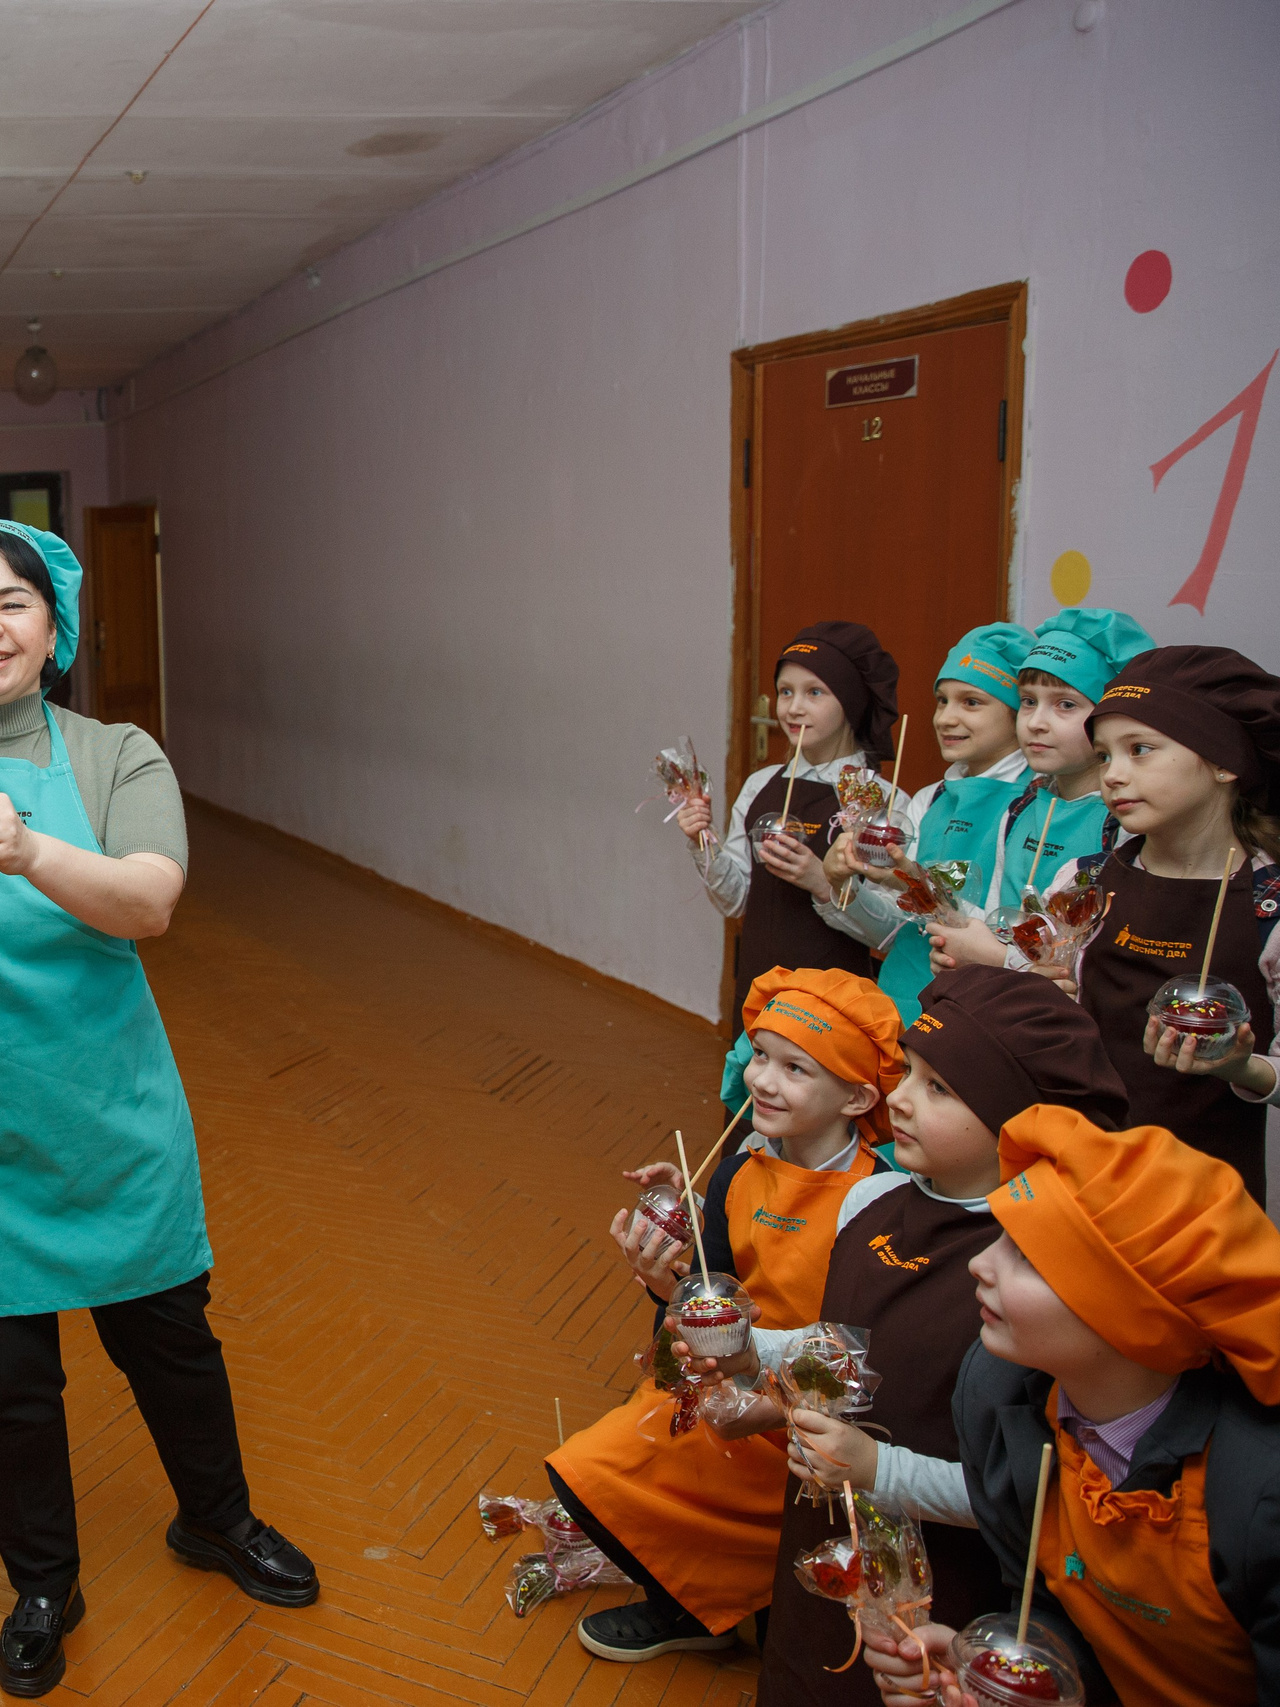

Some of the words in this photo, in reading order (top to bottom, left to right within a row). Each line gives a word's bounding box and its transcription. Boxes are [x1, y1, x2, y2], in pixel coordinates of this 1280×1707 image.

[845, 367, 896, 385] НАЧАЛЬНЫЕ
[852, 381, 890, 396] КЛАССЫ
[861, 416, 883, 442] 12
